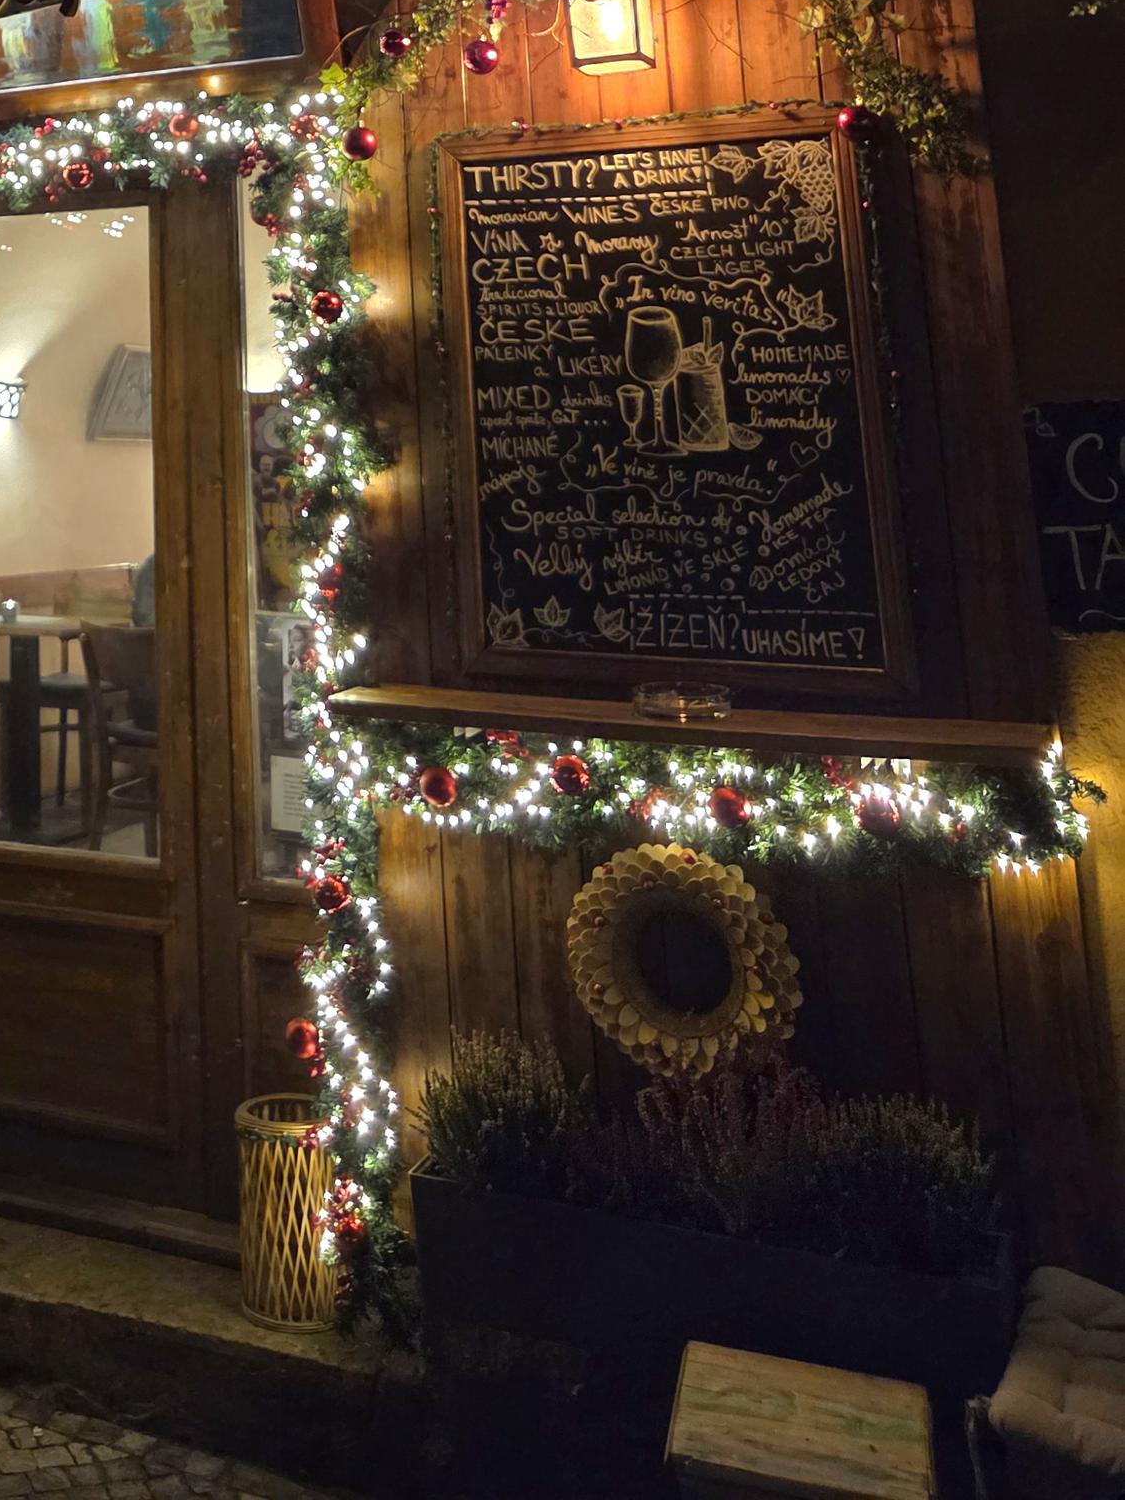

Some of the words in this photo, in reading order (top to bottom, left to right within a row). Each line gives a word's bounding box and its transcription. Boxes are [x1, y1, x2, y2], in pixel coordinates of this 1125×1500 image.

[600, 150, 657, 171] LET'S
[658, 148, 698, 167] HAVE
[463, 157, 600, 194] THIRSTY?
[613, 172, 631, 189] A
[632, 164, 703, 189] DRINK!
[561, 202, 641, 225] WINES
[649, 194, 707, 217] ČESKÉ
[711, 195, 750, 213] PIVO
[670, 244, 734, 261] CZECH
[744, 239, 795, 256] LIGHT
[471, 253, 591, 286] CZECH
[475, 302, 543, 317] SPIRITS
[555, 300, 603, 315] LIQUOR
[659, 283, 697, 303] vino
[478, 315, 596, 345] ČESKÉ
[533, 366, 550, 378] a
[557, 347, 623, 377] LIKÉRY
[751, 343, 850, 364] HOMEMADE
[728, 362, 832, 386] lemonades
[477, 384, 551, 411] MIXED
[560, 380, 613, 408] drinks
[745, 384, 823, 405] DOMÁCÍ
[743, 405, 838, 450] limonády
[481, 430, 560, 461] MÍCHANÉ
[478, 460, 548, 501] nápoje
[623, 457, 659, 479] víně
[659, 464, 688, 498] je
[500, 492, 606, 537] Special
[611, 494, 706, 527] selection
[710, 501, 733, 534] of
[748, 471, 854, 543] Homemade
[555, 526, 618, 541] SOFT
[631, 526, 708, 549] DRINKS
[771, 531, 800, 550] ICE
[800, 507, 837, 530] TEA
[512, 541, 594, 591] Velký
[602, 539, 664, 577] výběr
[673, 558, 698, 578] VE
[702, 540, 750, 571] SKLE
[777, 548, 843, 593] LEDOVÝ
[800, 571, 846, 604] ČAJ
[635, 601, 741, 651] ŽÍZEŇ?
[741, 617, 865, 660] UHASÍME!
